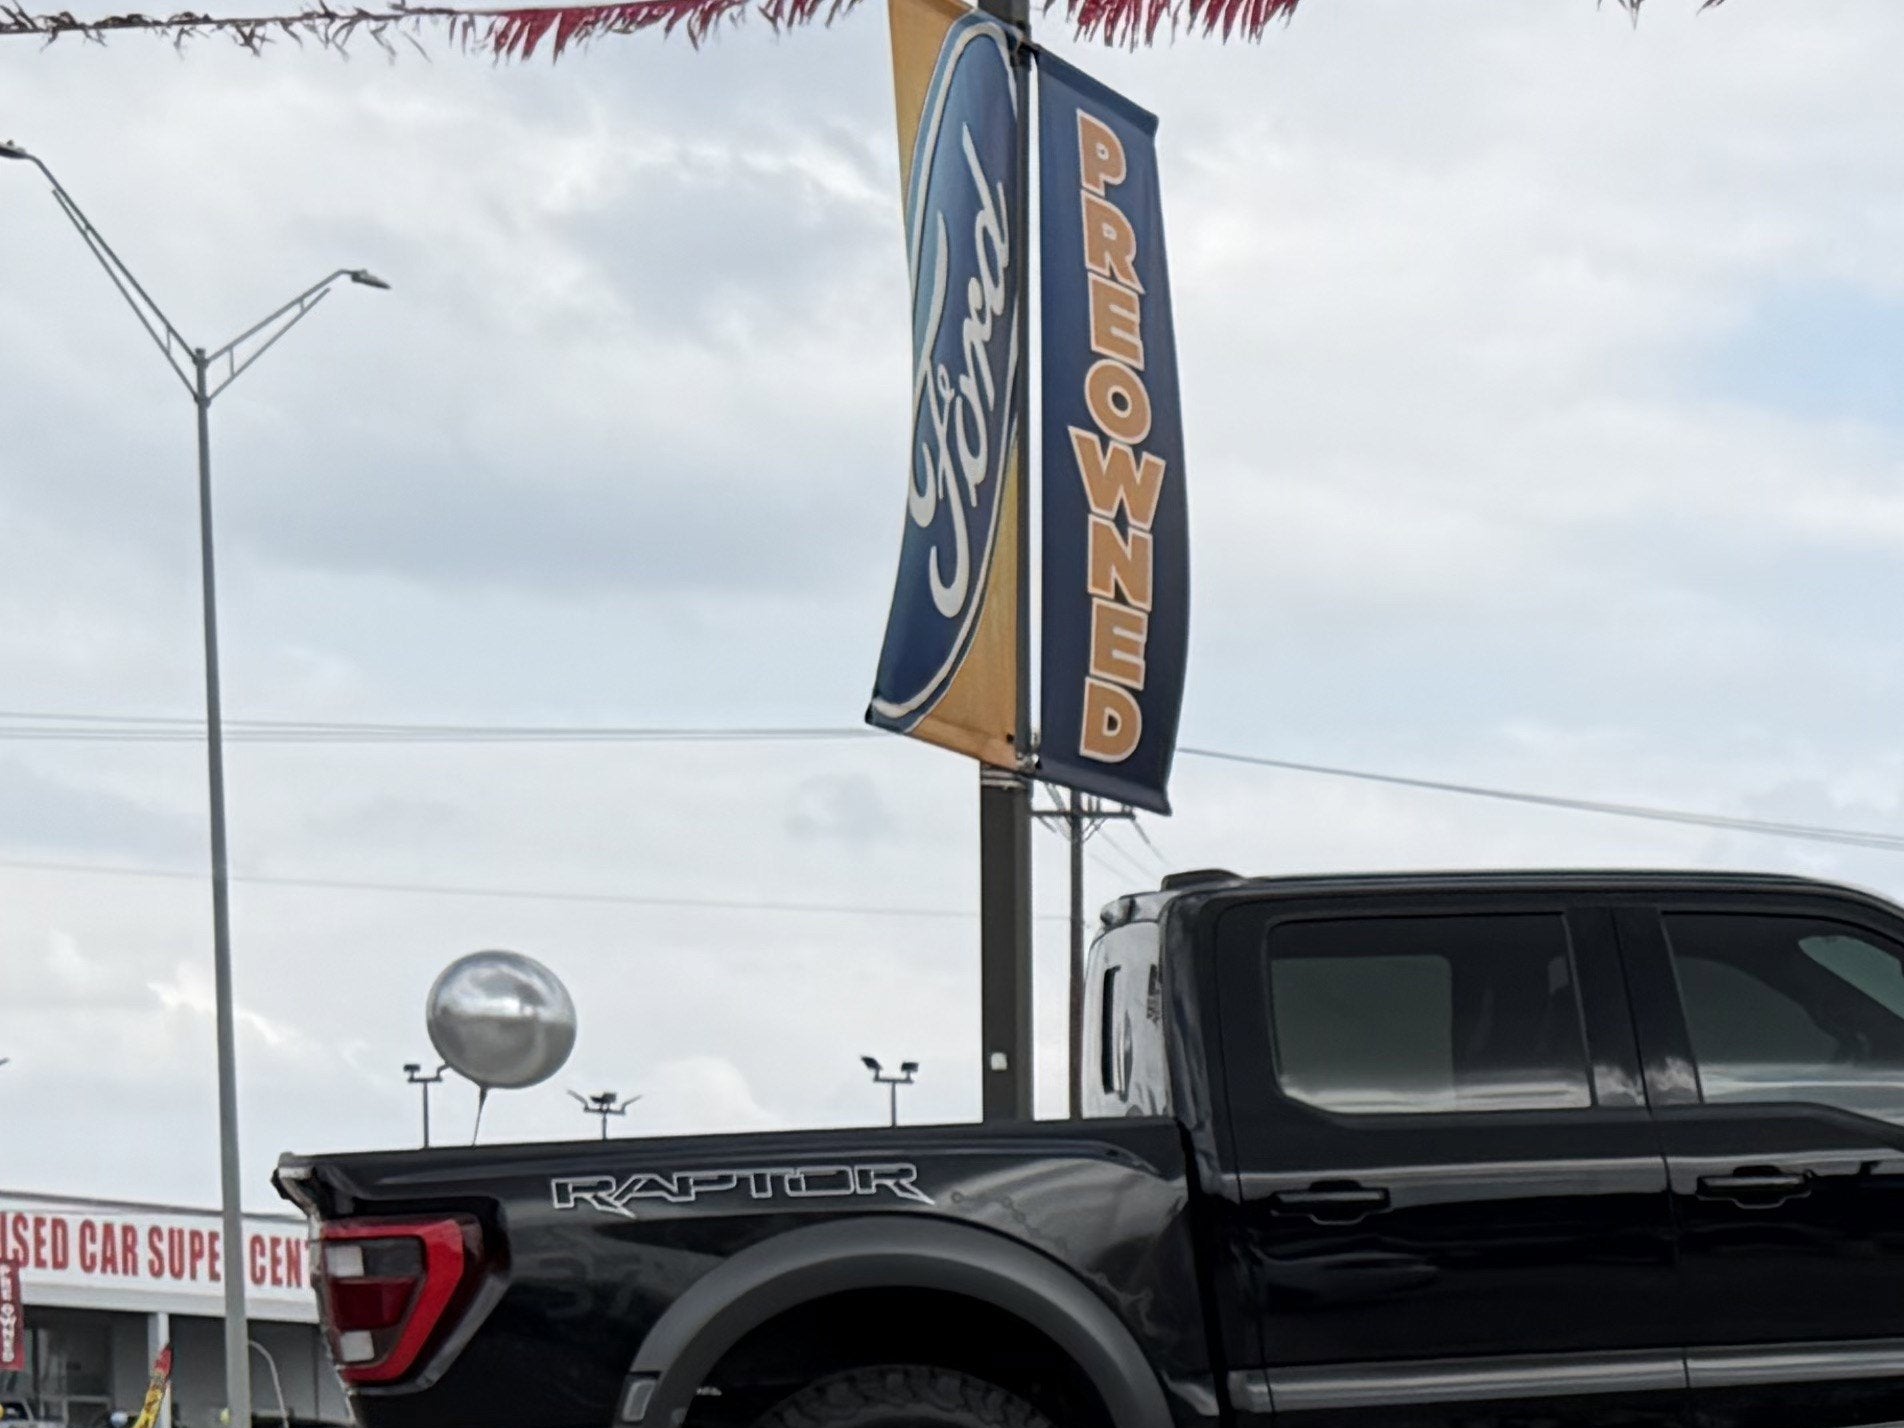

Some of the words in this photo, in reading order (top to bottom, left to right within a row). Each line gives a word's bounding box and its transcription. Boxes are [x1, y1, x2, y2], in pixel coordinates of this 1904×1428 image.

[908, 121, 1009, 618] Ford
[1068, 108, 1167, 764] PREOWNED
[78, 1218, 140, 1277] CAR
[147, 1224, 222, 1283] SUPE
[249, 1233, 309, 1289] CEN
[551, 1163, 936, 1220] RAPTOR
